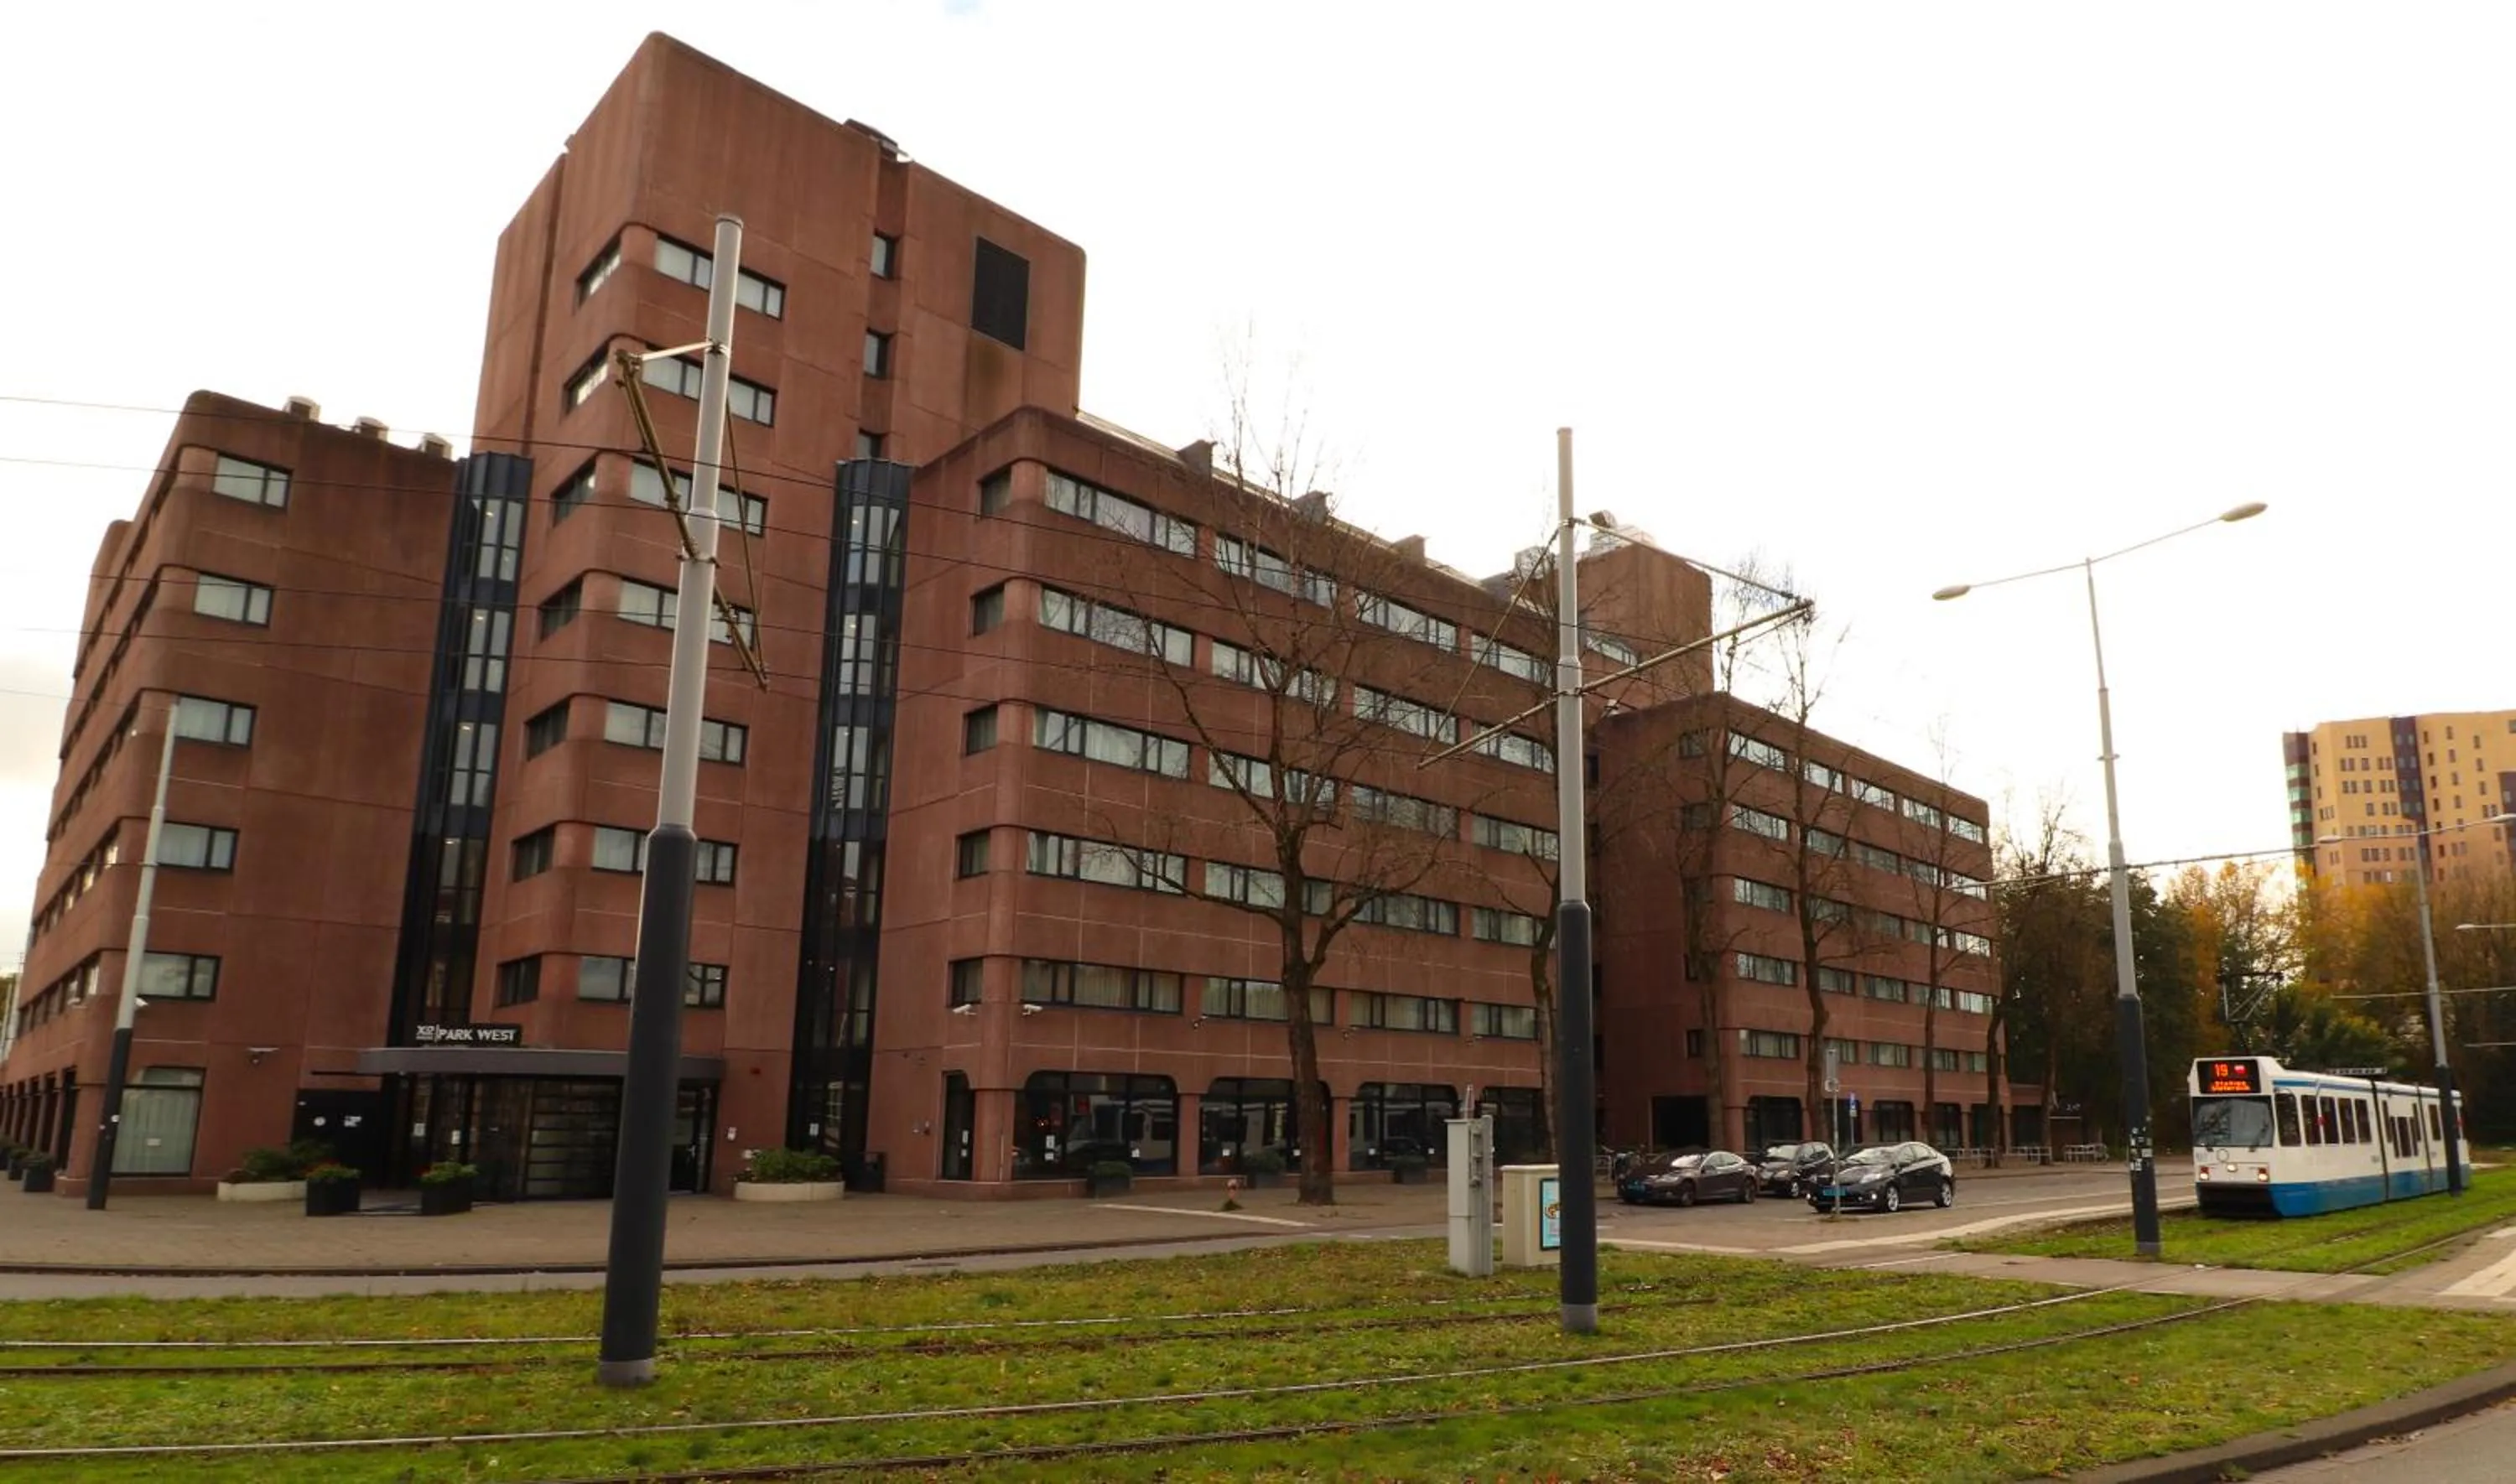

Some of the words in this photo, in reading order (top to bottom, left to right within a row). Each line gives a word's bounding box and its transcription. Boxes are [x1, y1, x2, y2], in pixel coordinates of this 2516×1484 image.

[439, 1029, 473, 1040] PARK
[477, 1029, 517, 1040] WEST
[2214, 1063, 2228, 1077] 19
